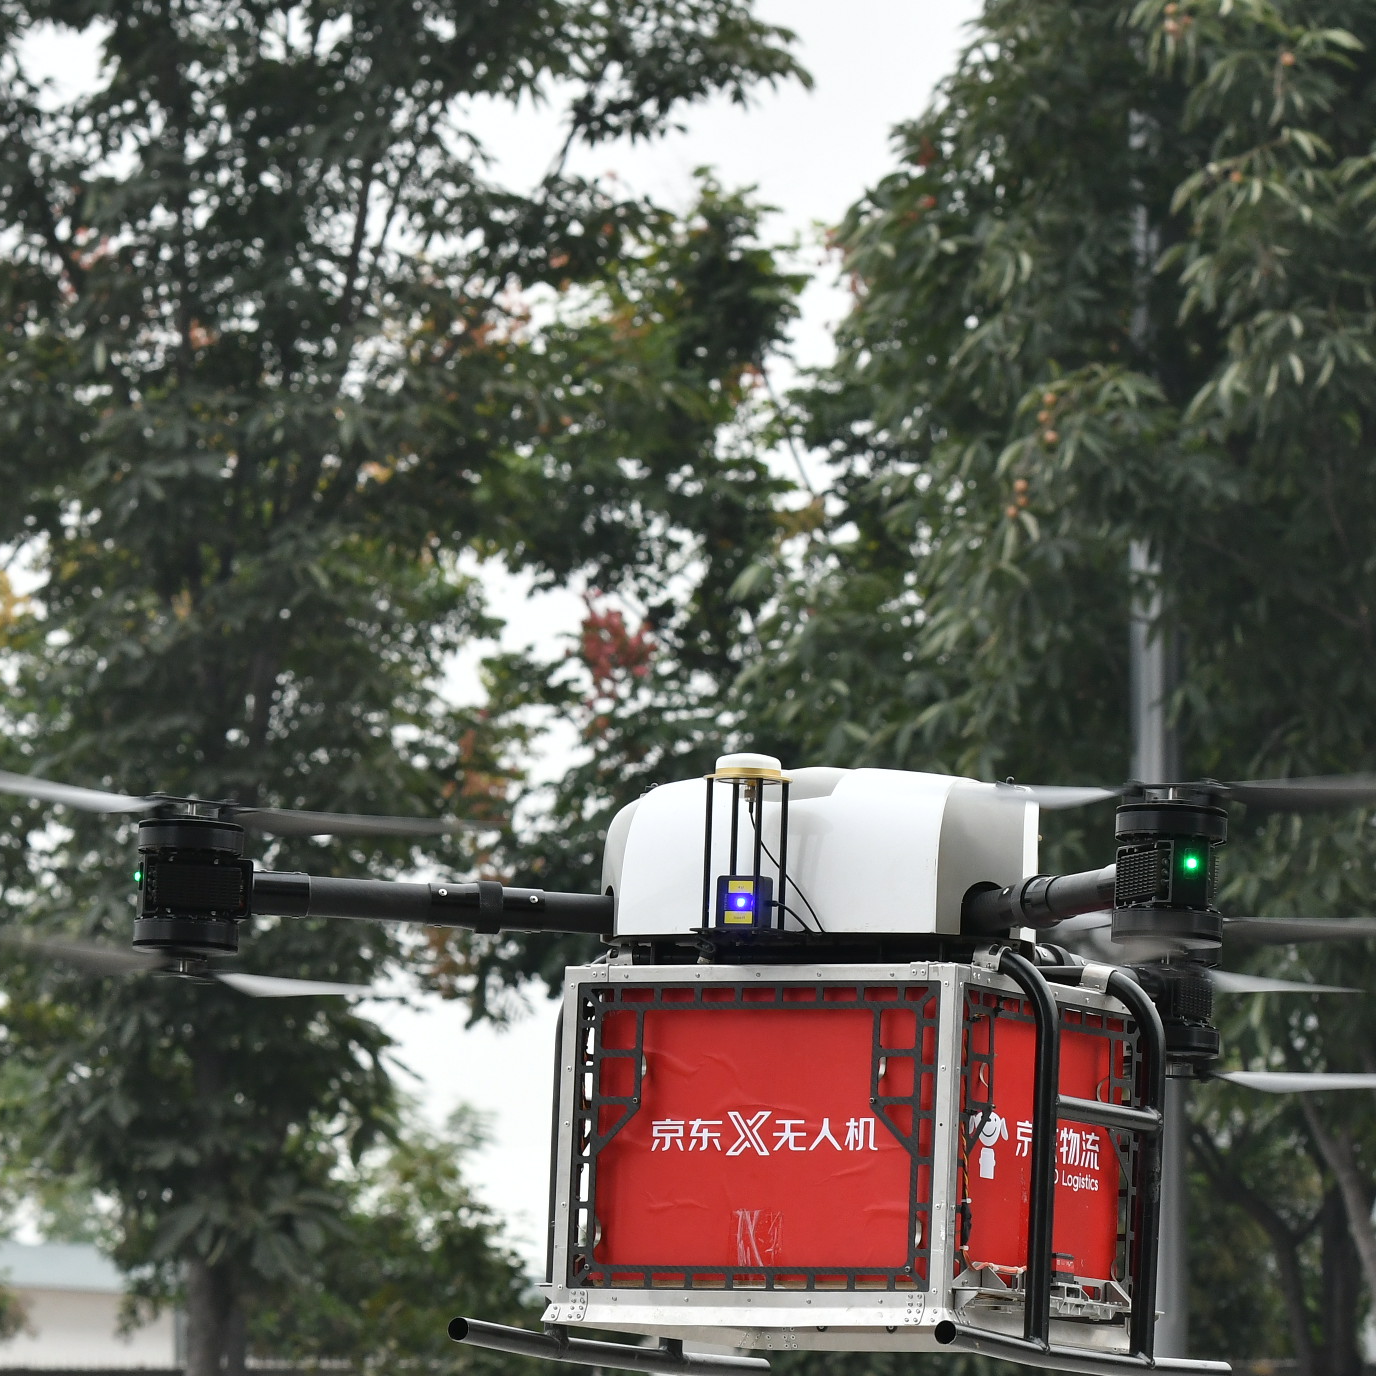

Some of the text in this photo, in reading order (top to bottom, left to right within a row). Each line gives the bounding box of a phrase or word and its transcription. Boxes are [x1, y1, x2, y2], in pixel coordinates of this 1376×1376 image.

[1015, 1120, 1100, 1171] 京物流
[1061, 1169, 1099, 1192] Logistics
